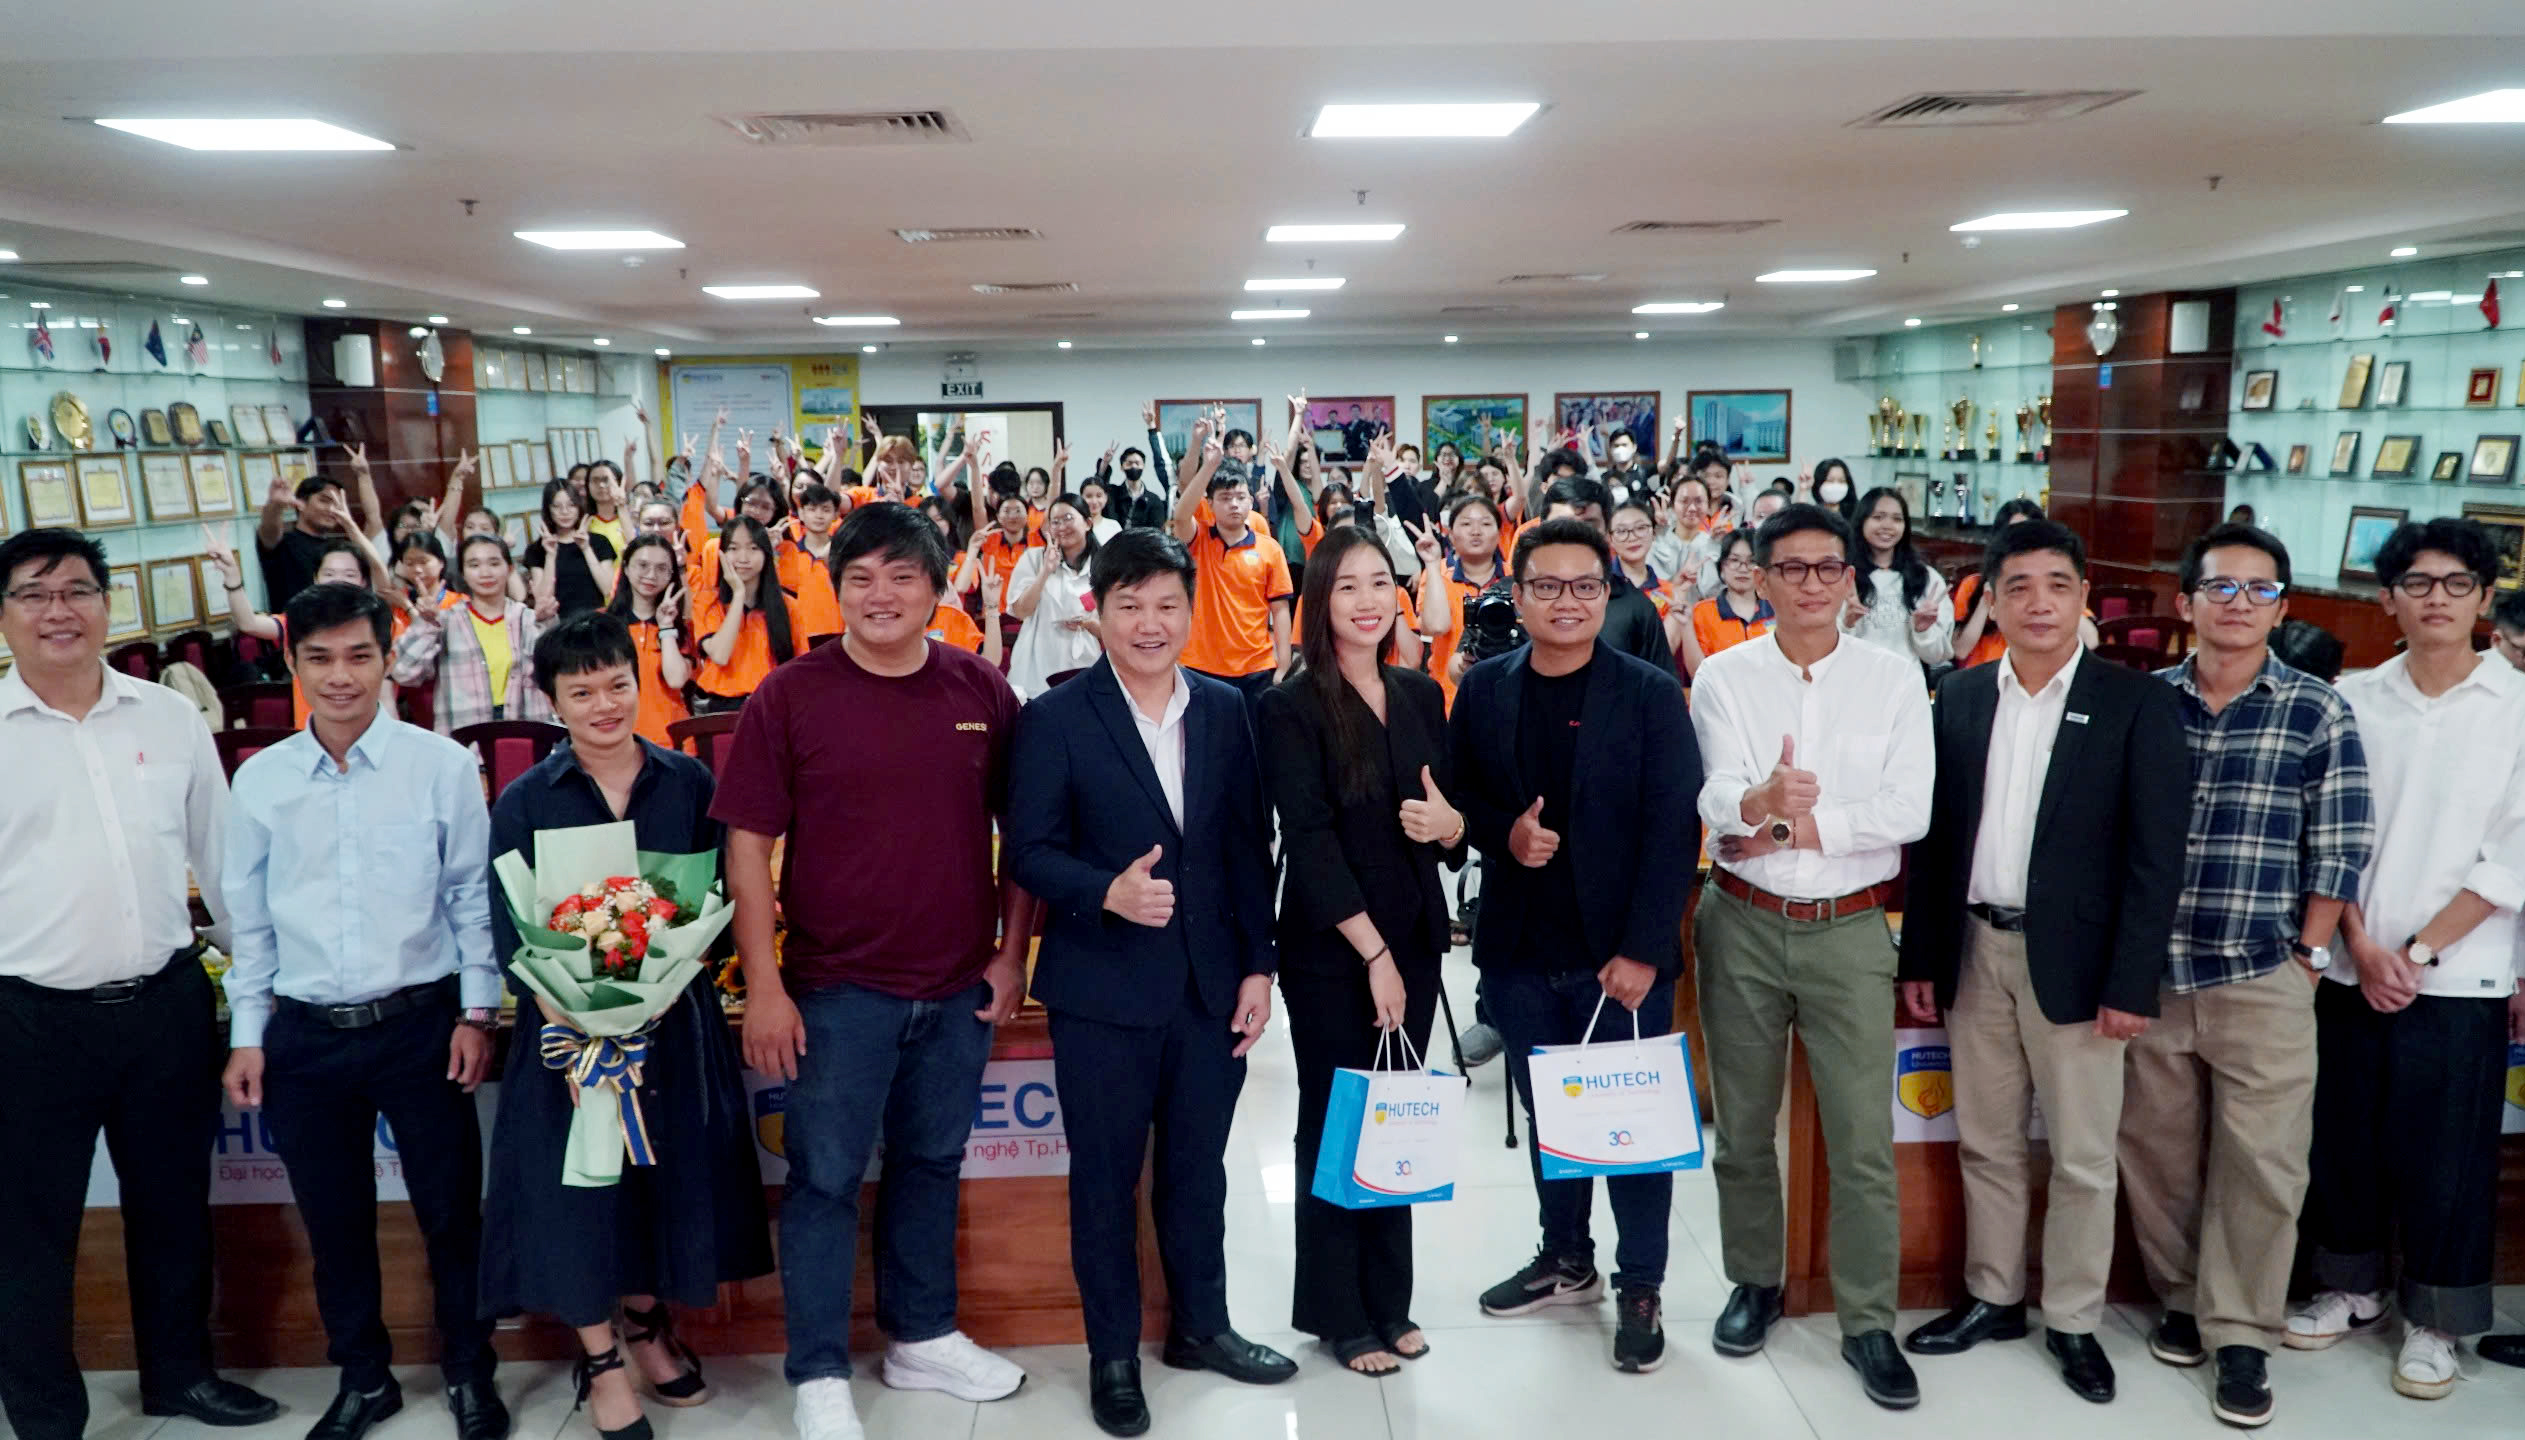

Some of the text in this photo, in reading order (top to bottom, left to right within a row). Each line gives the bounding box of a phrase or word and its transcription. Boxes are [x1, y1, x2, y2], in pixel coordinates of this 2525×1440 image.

[947, 383, 977, 396] EXIT
[1586, 1071, 1661, 1089] HUTECH
[1388, 1102, 1440, 1117] HUTECH
[974, 1139, 1070, 1161] nghệ Tp.H
